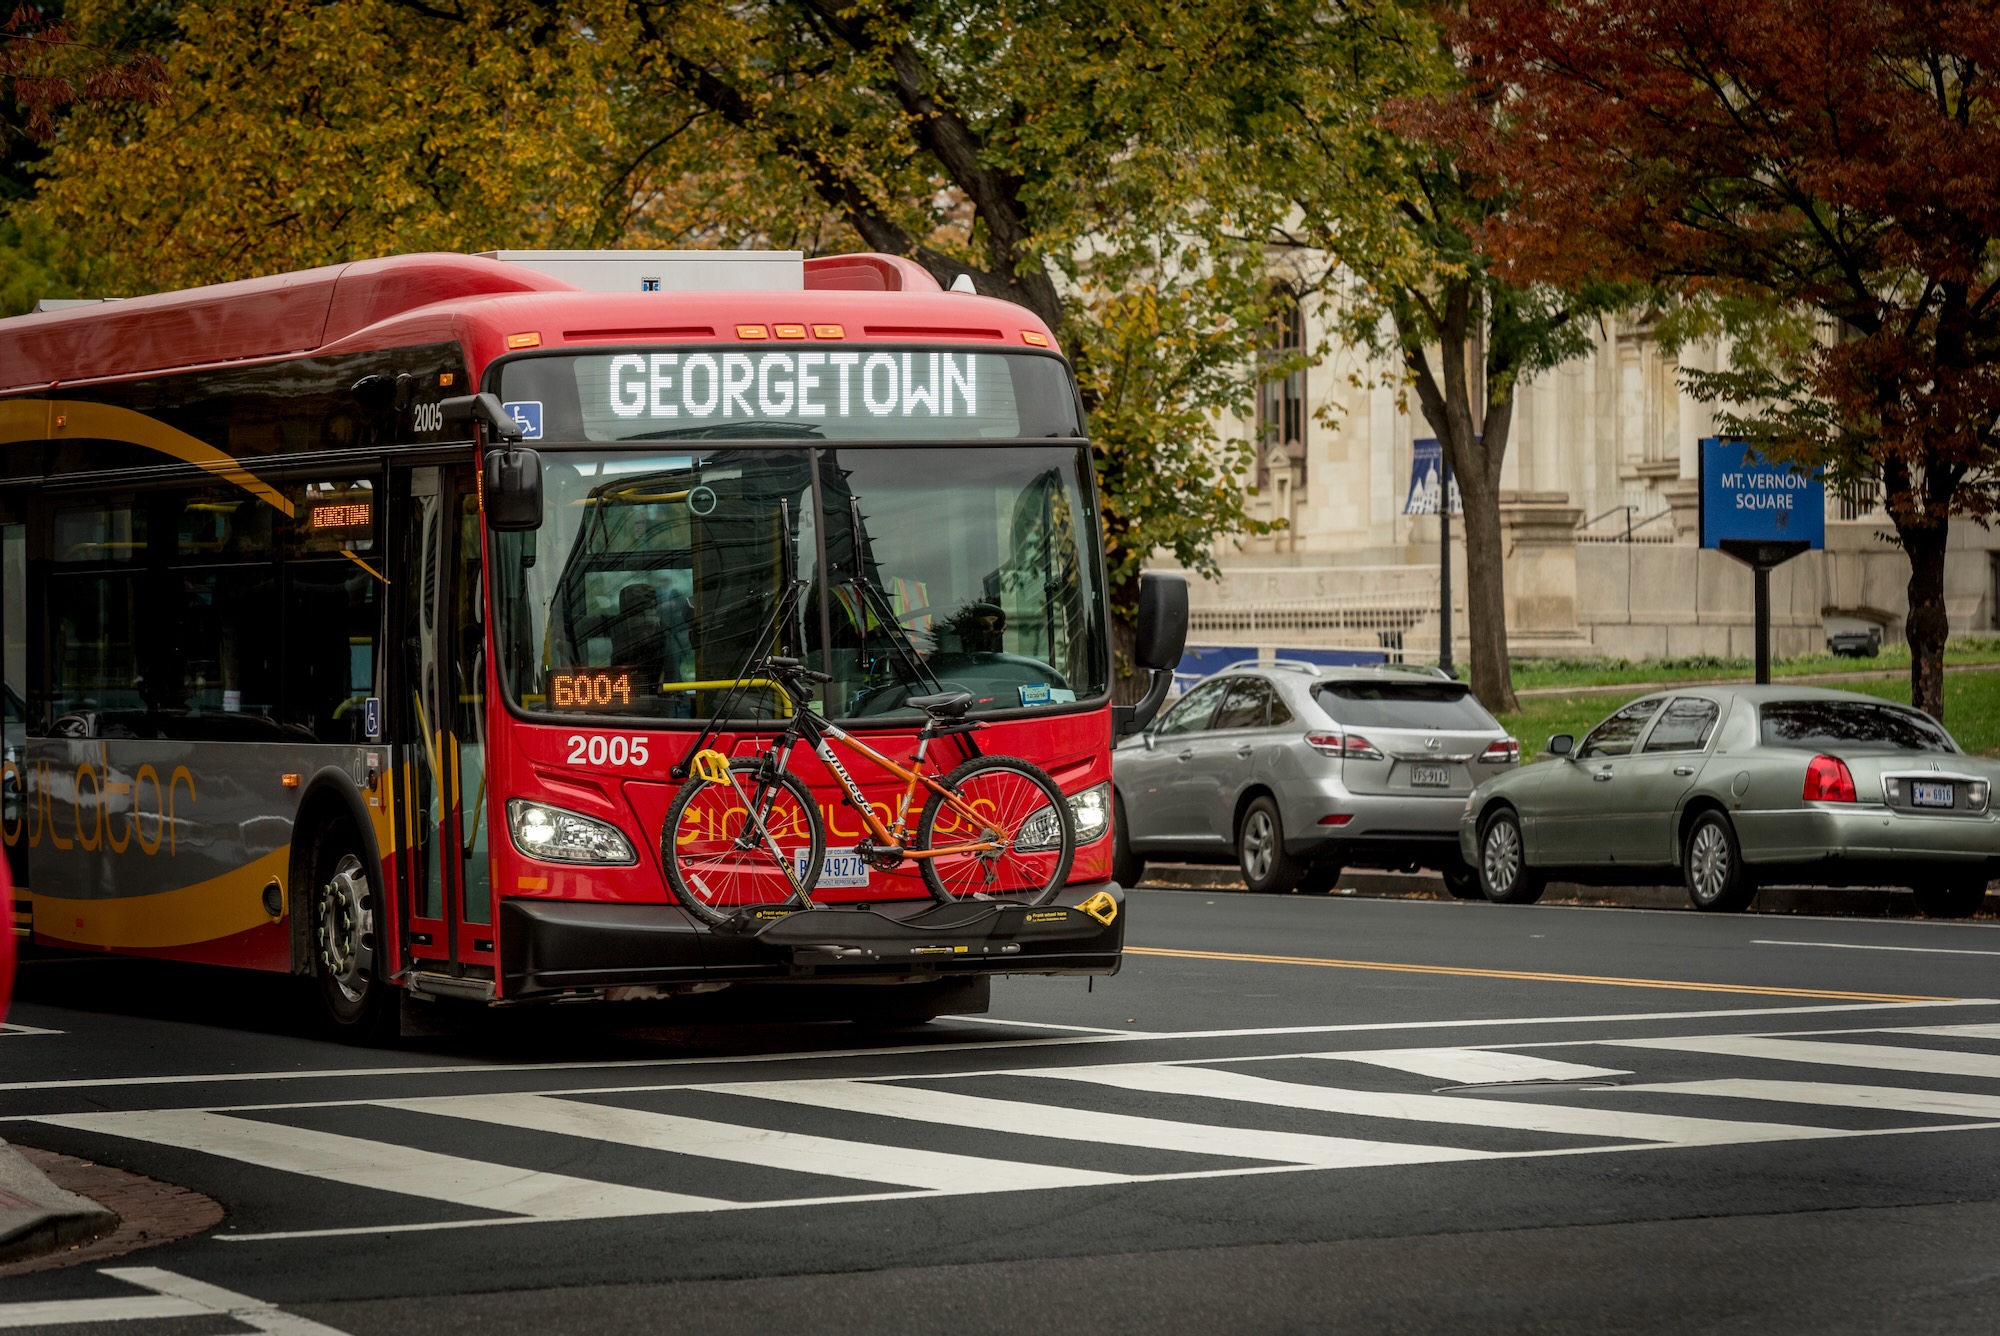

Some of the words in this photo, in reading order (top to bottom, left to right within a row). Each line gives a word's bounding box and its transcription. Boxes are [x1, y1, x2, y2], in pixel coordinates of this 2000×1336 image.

[609, 352, 977, 417] GEORGETOWN
[413, 402, 443, 432] 2005
[1721, 473, 1745, 489] MT.
[1747, 474, 1807, 489] VERNON
[1736, 493, 1794, 510] SQUARE
[1217, 571, 1441, 599] ERSITY
[554, 674, 631, 706] 6004
[567, 735, 649, 766] 2005
[824, 748, 875, 816] univega
[825, 857, 865, 877] 49278
